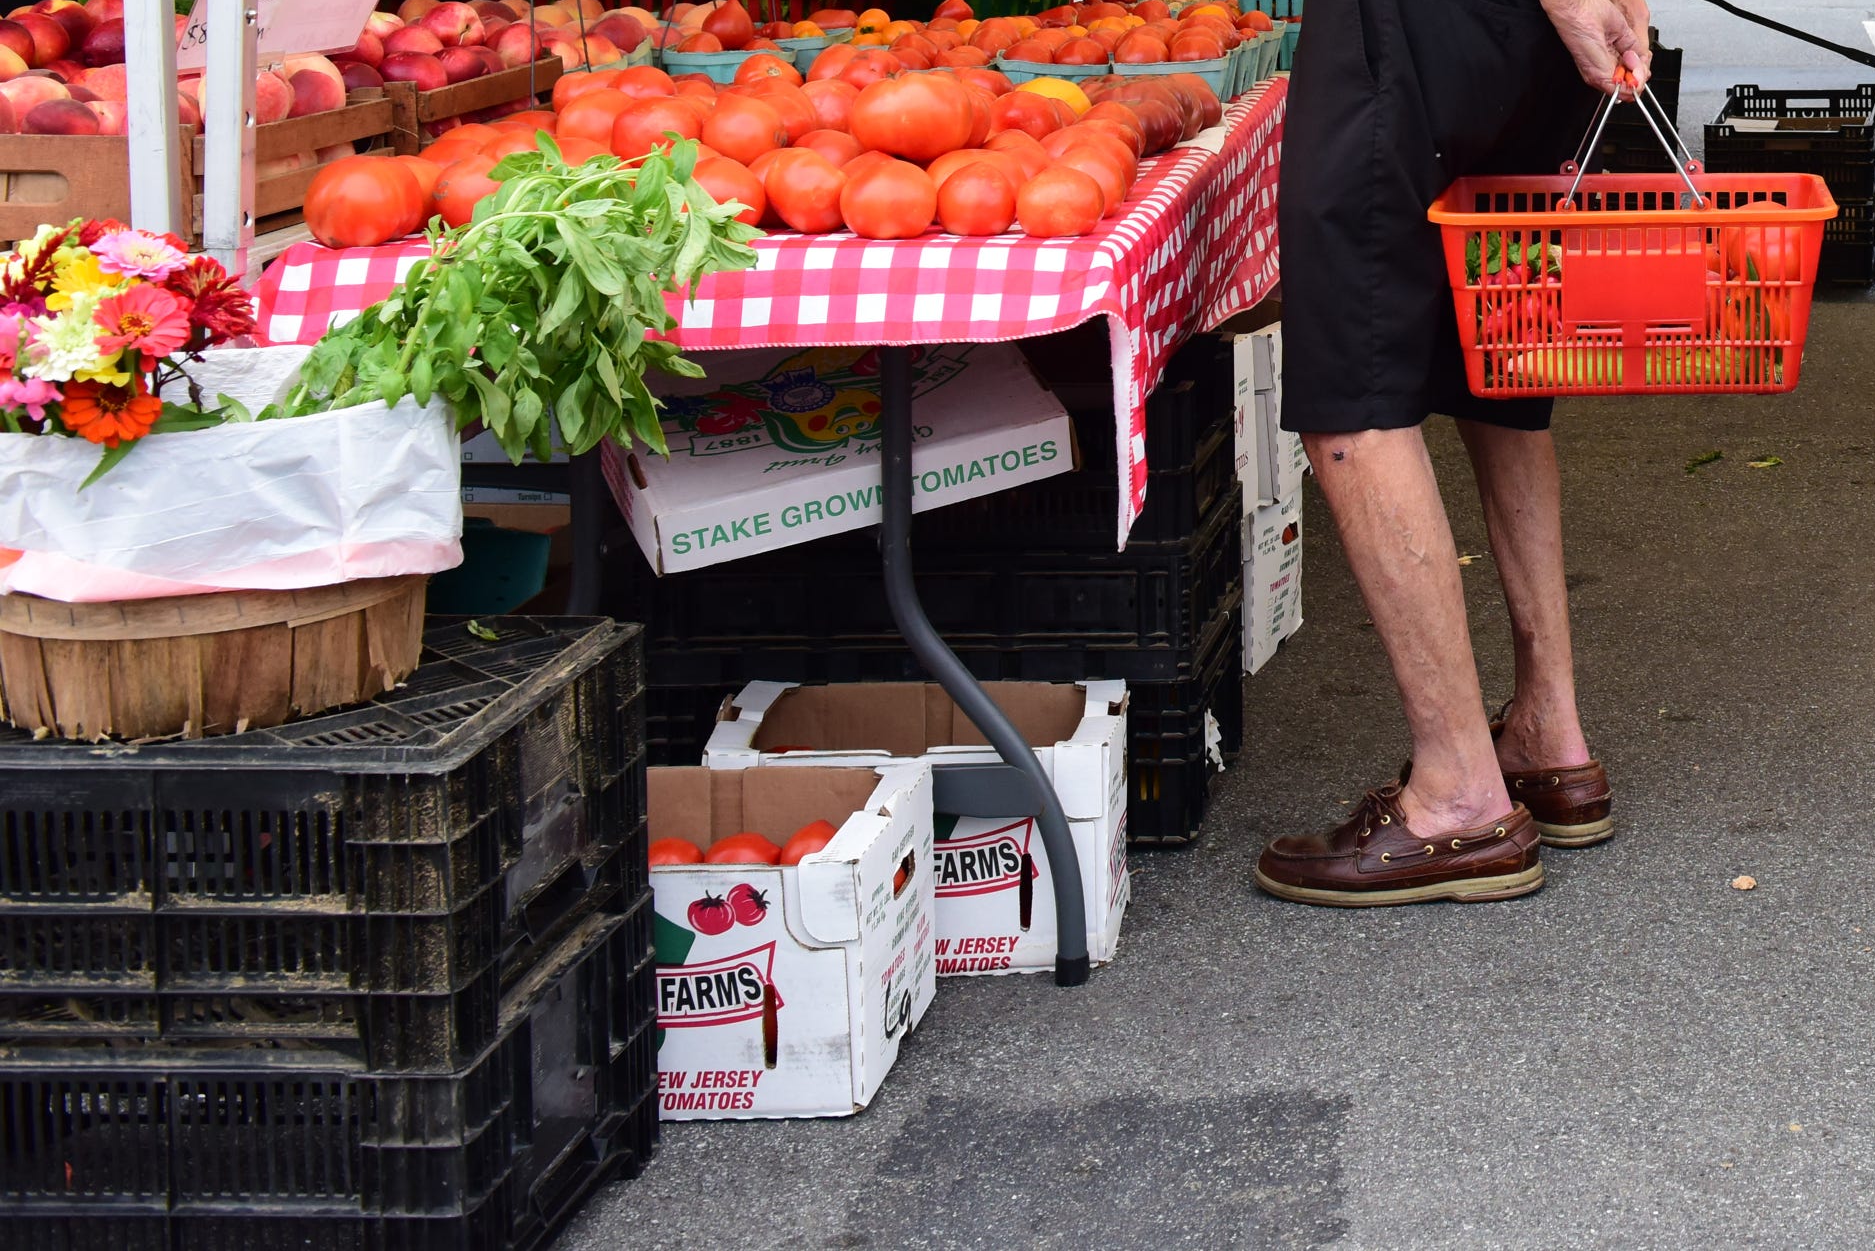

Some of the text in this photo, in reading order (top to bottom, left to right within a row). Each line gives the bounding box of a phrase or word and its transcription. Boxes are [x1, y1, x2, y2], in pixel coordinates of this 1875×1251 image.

[705, 435, 760, 451] 1887
[672, 512, 772, 555] STAKE
[780, 488, 882, 530] GROWN
[934, 842, 1019, 885] FARMS
[954, 936, 1019, 955] JERSEY
[661, 967, 761, 1012] FARMS
[658, 1070, 763, 1089] EW JERSEY
